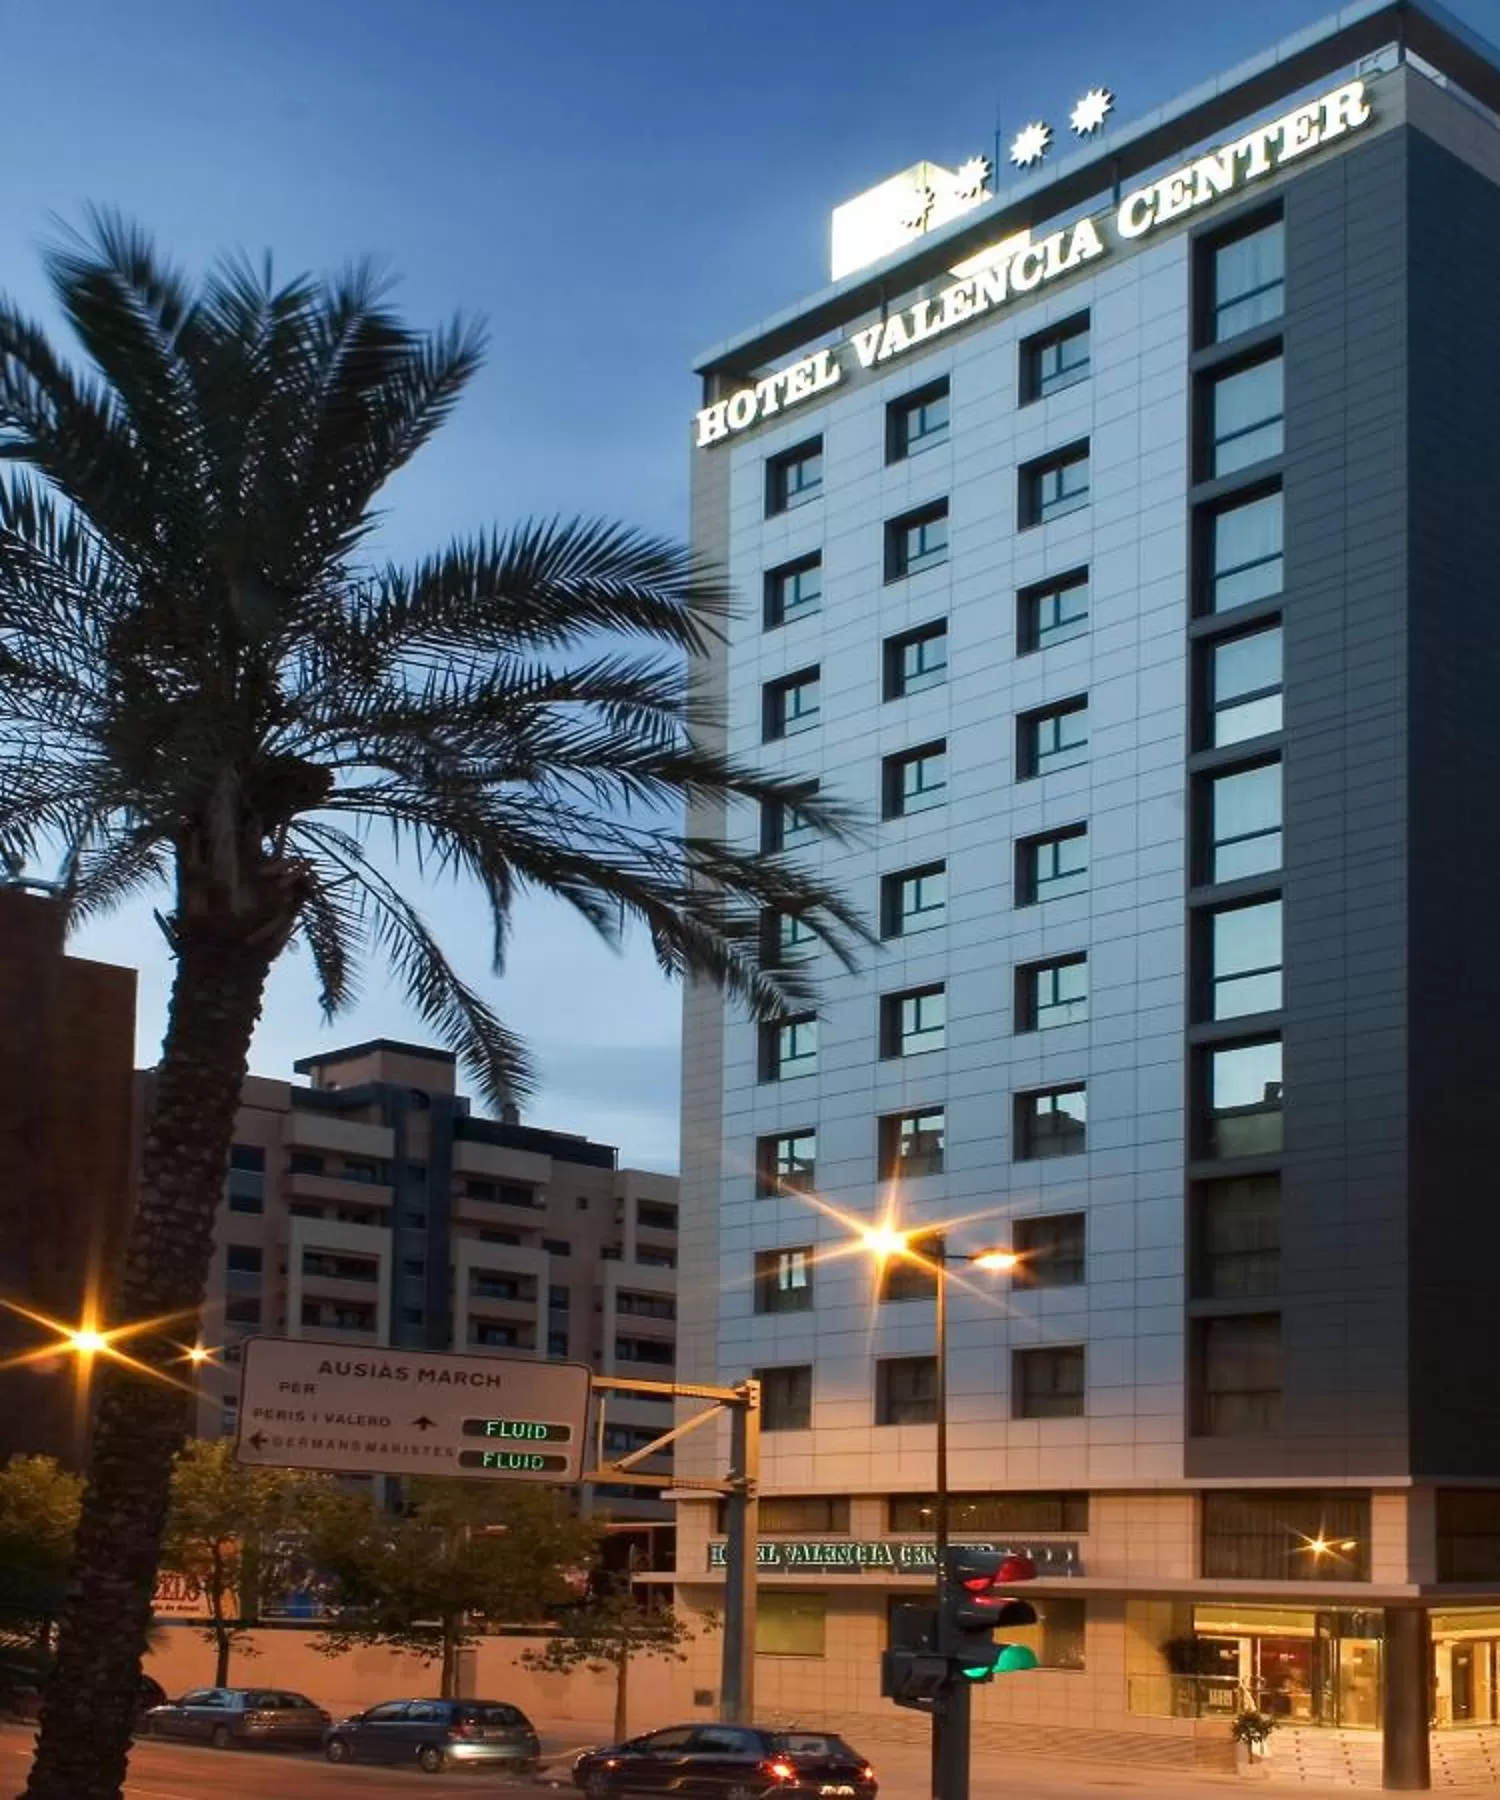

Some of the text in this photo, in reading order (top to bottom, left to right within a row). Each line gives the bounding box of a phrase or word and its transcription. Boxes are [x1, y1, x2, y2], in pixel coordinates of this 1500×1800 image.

[696, 80, 1373, 450] HOTEL VALENCIA CENTER
[279, 1380, 316, 1395] PER
[418, 1367, 501, 1389] MARCH
[252, 1407, 305, 1424] PERIS
[323, 1411, 391, 1428] VALERO
[485, 1420, 548, 1441] FLUID
[482, 1450, 545, 1471] FLUID
[785, 1544, 895, 1566] VALENCIA
